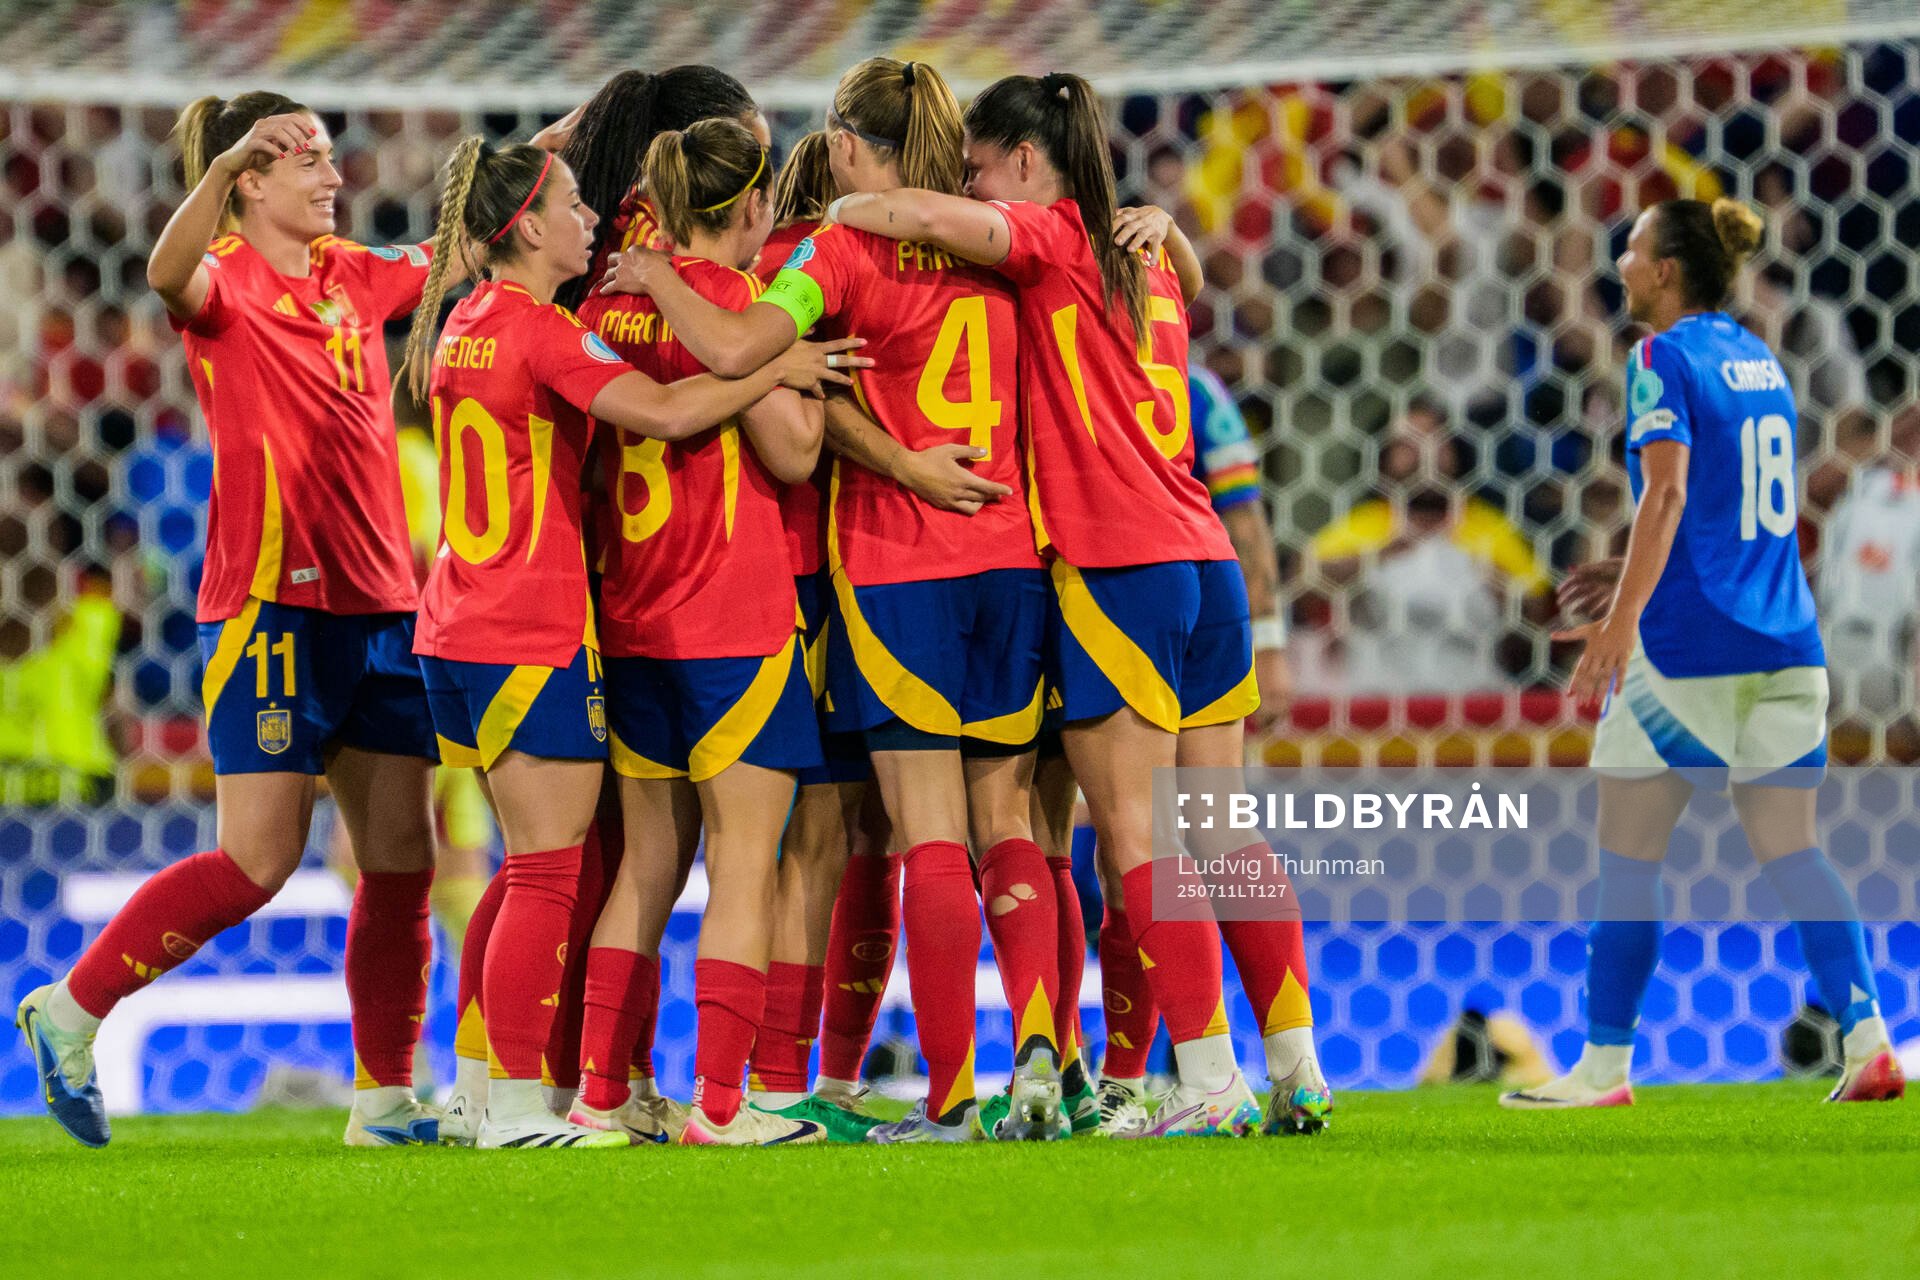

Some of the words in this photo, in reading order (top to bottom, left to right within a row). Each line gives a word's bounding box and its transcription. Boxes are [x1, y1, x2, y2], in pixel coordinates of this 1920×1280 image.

[325, 326, 365, 393] 11
[916, 296, 1002, 462] 4
[1136, 295, 1191, 460] 5
[1740, 413, 1797, 541] 18
[246, 632, 296, 698] 11
